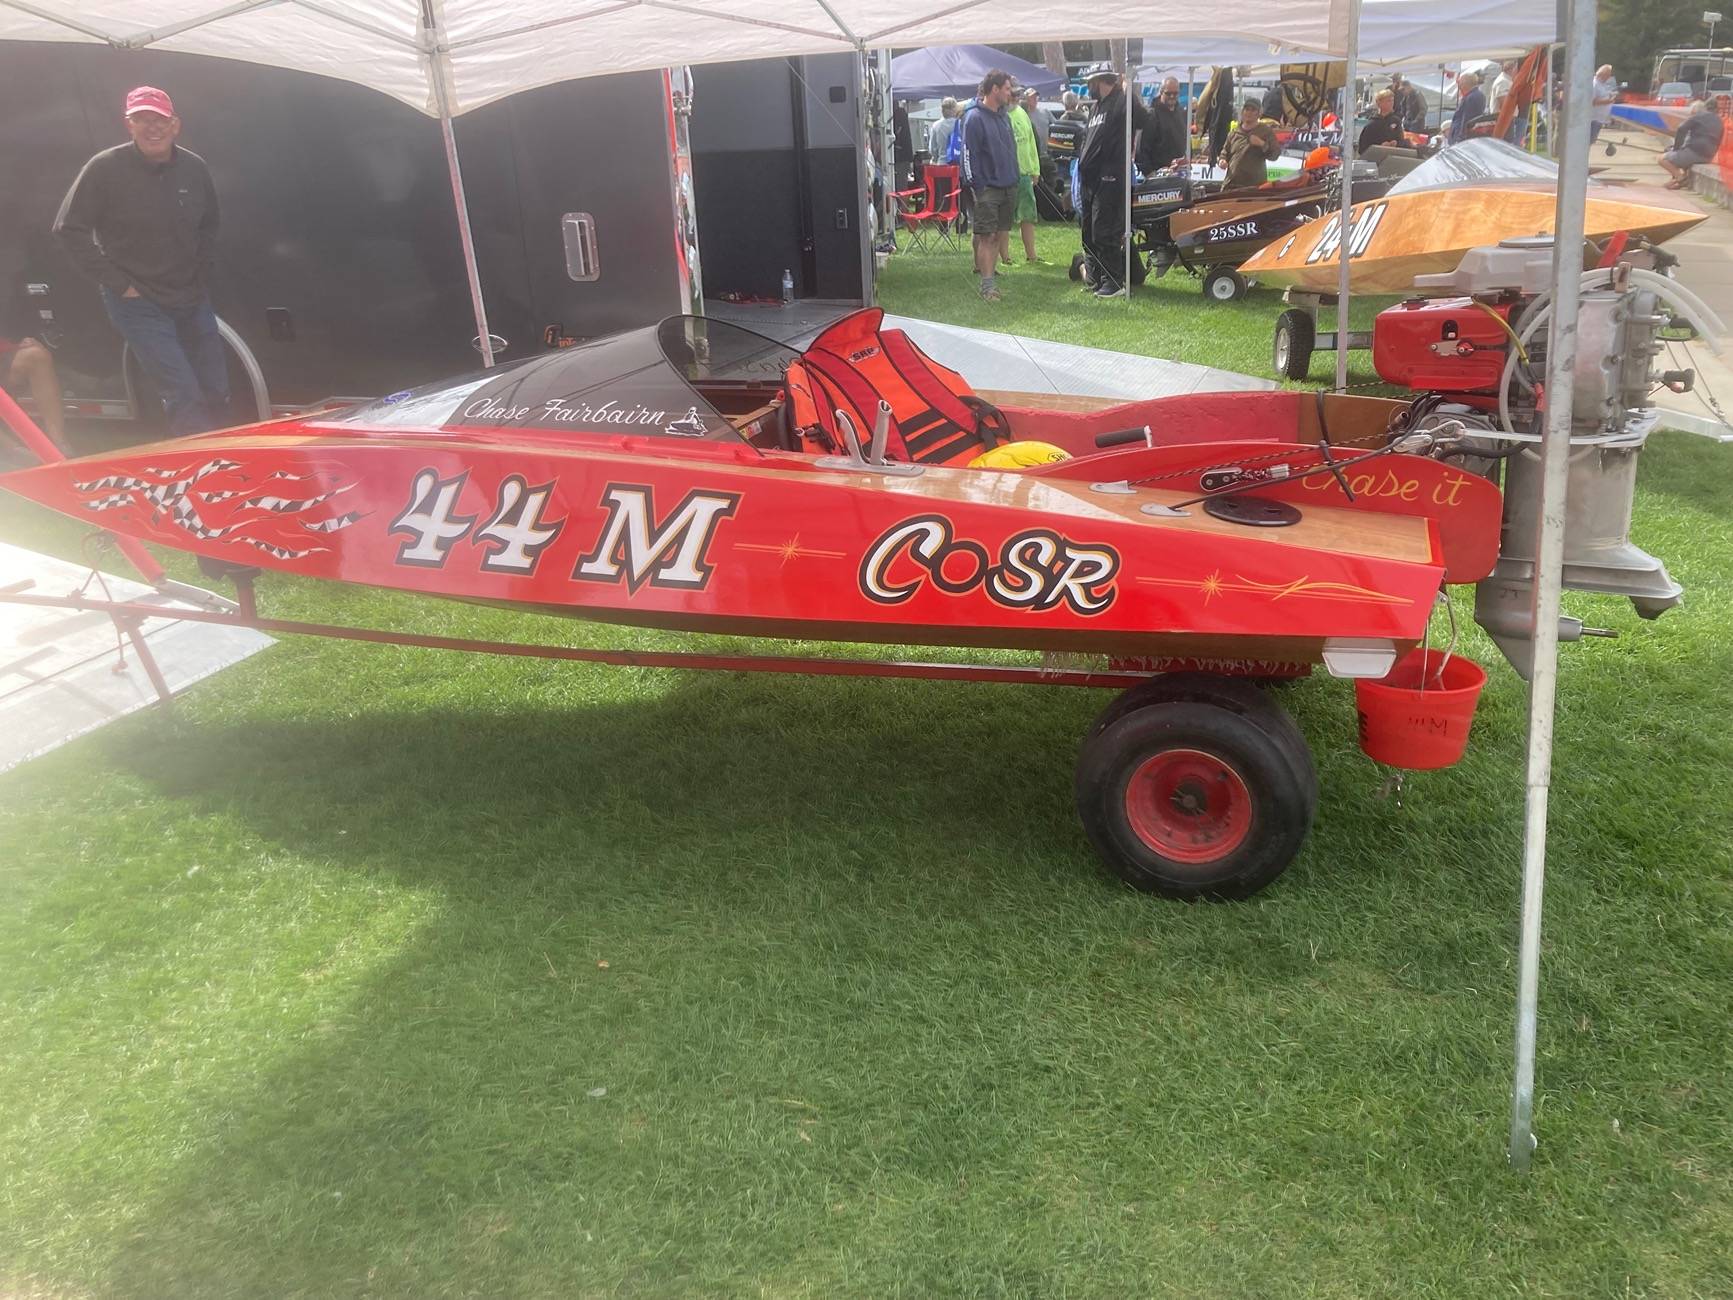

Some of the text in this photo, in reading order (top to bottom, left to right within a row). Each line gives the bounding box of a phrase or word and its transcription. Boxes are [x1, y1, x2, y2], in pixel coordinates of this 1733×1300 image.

[1137, 190, 1182, 203] MERCURY
[1209, 220, 1258, 241] 25SSR
[463, 397, 666, 426] Chase Fairbairn
[1432, 471, 1473, 507] it
[388, 467, 744, 598] 44 M
